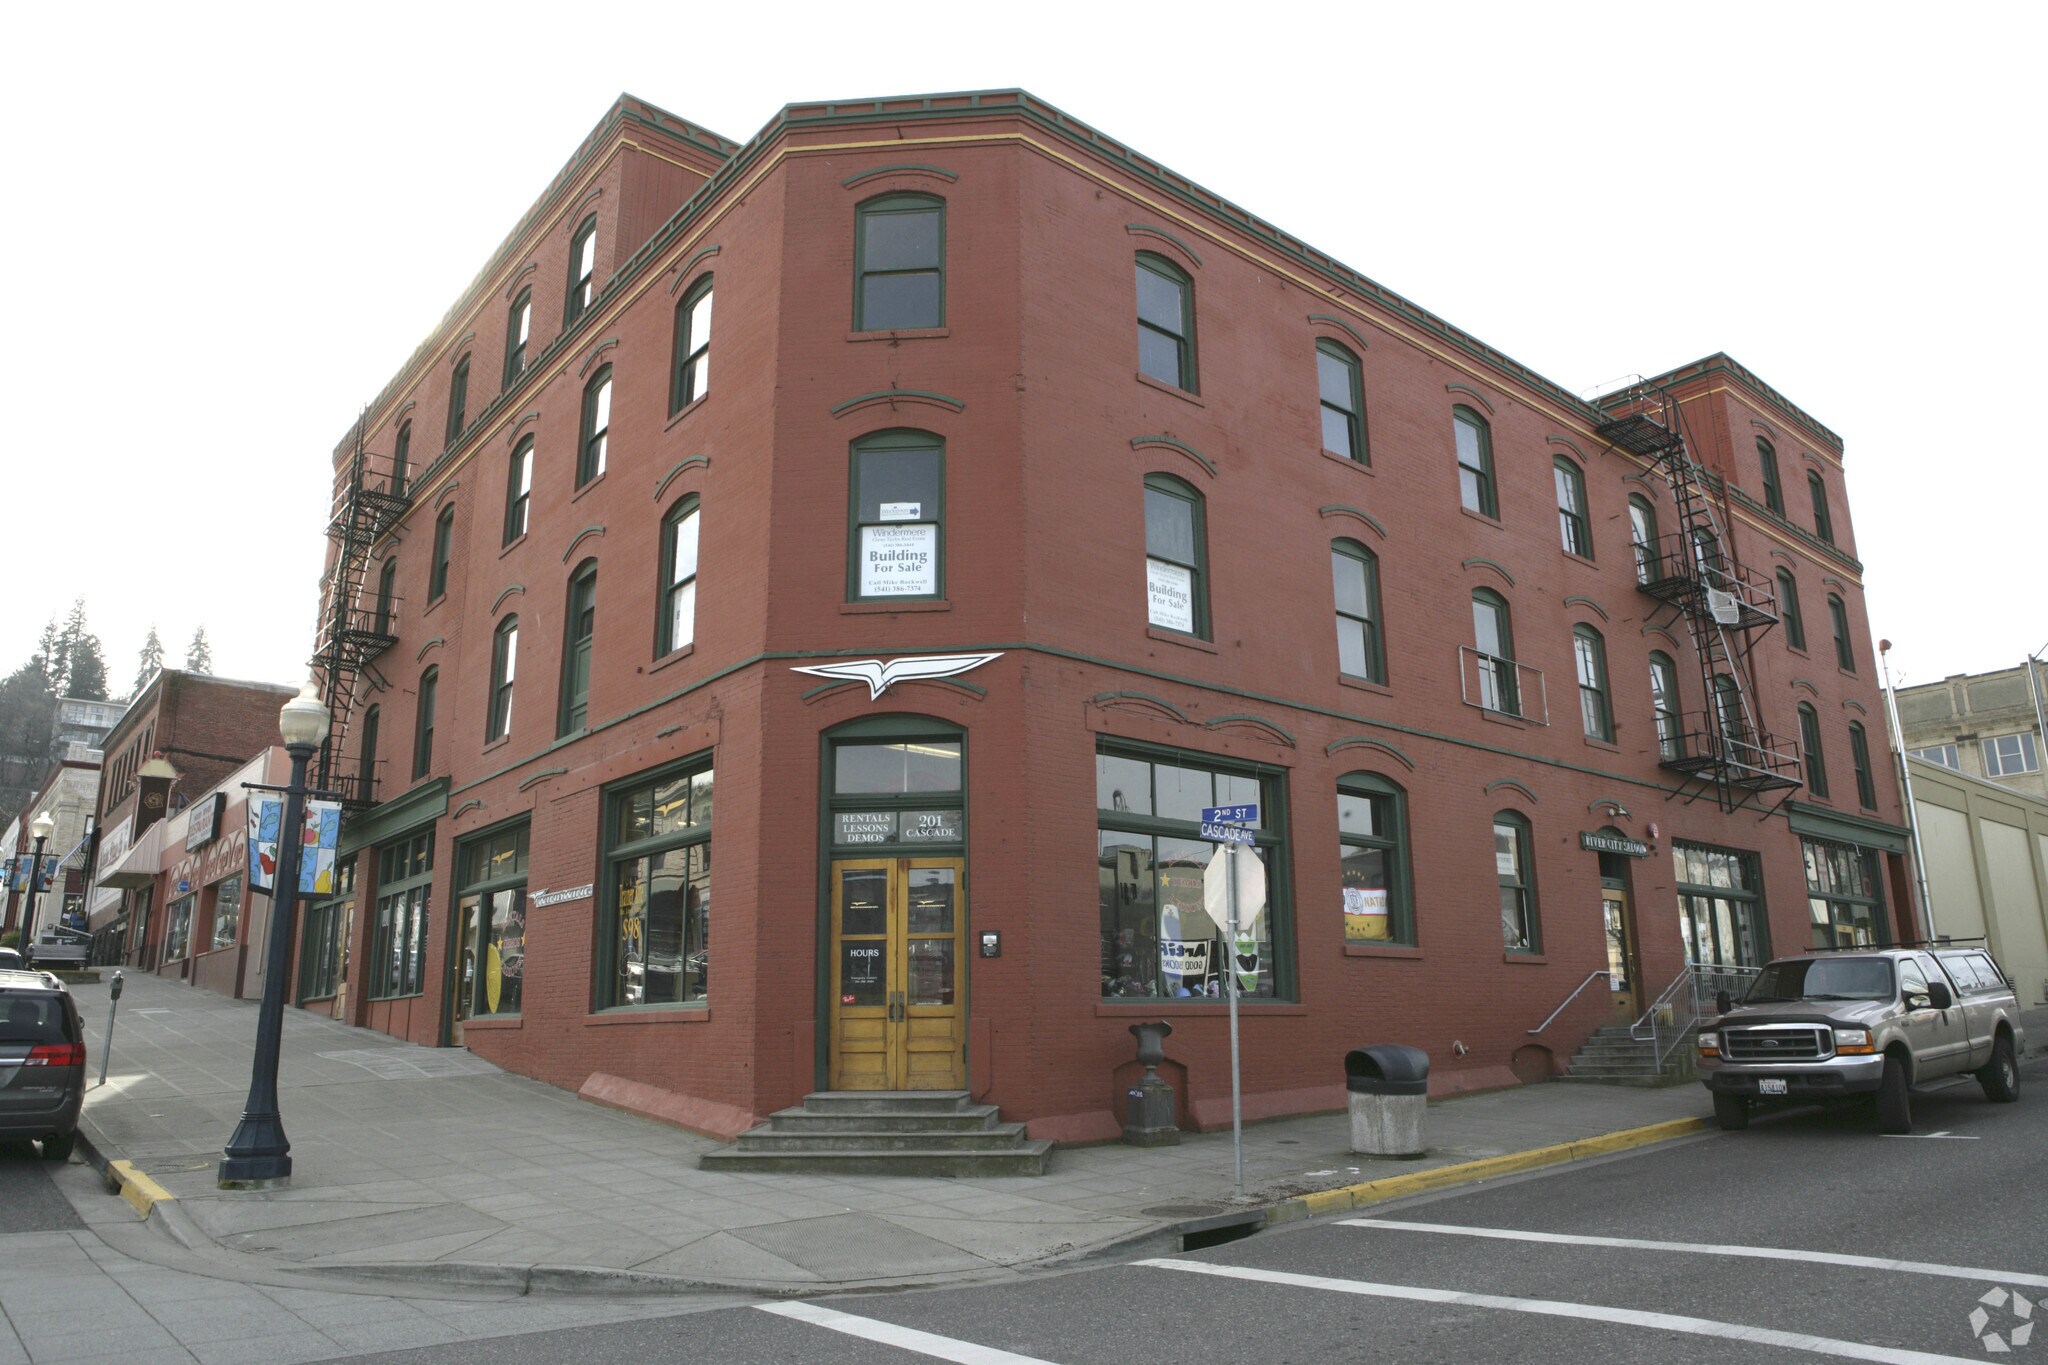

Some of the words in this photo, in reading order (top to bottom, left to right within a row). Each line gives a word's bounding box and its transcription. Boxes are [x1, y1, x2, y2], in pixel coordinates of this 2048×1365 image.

[872, 528, 926, 537] Windermere
[869, 549, 928, 564] Building
[874, 563, 893, 573] For
[898, 562, 922, 572] Sale
[1149, 581, 1187, 604] Building
[1153, 594, 1165, 605] For
[1168, 598, 1184, 610] Sale
[842, 814, 890, 823] RENTALS
[918, 815, 942, 827] 201
[1213, 808, 1231, 822] 2ND
[1235, 808, 1247, 819] ST
[843, 824, 889, 833] LESSONS
[906, 828, 956, 837] CASCADE
[1201, 823, 1240, 841] CASCADE
[1240, 829, 1253, 841] AVE
[847, 833, 885, 842] DEMOS
[1585, 835, 1606, 848] RIVER
[1607, 839, 1622, 851] CITY
[1623, 841, 1647, 854] SALOON
[537, 885, 593, 906] WINDWING
[850, 949, 879, 957] HOURS
